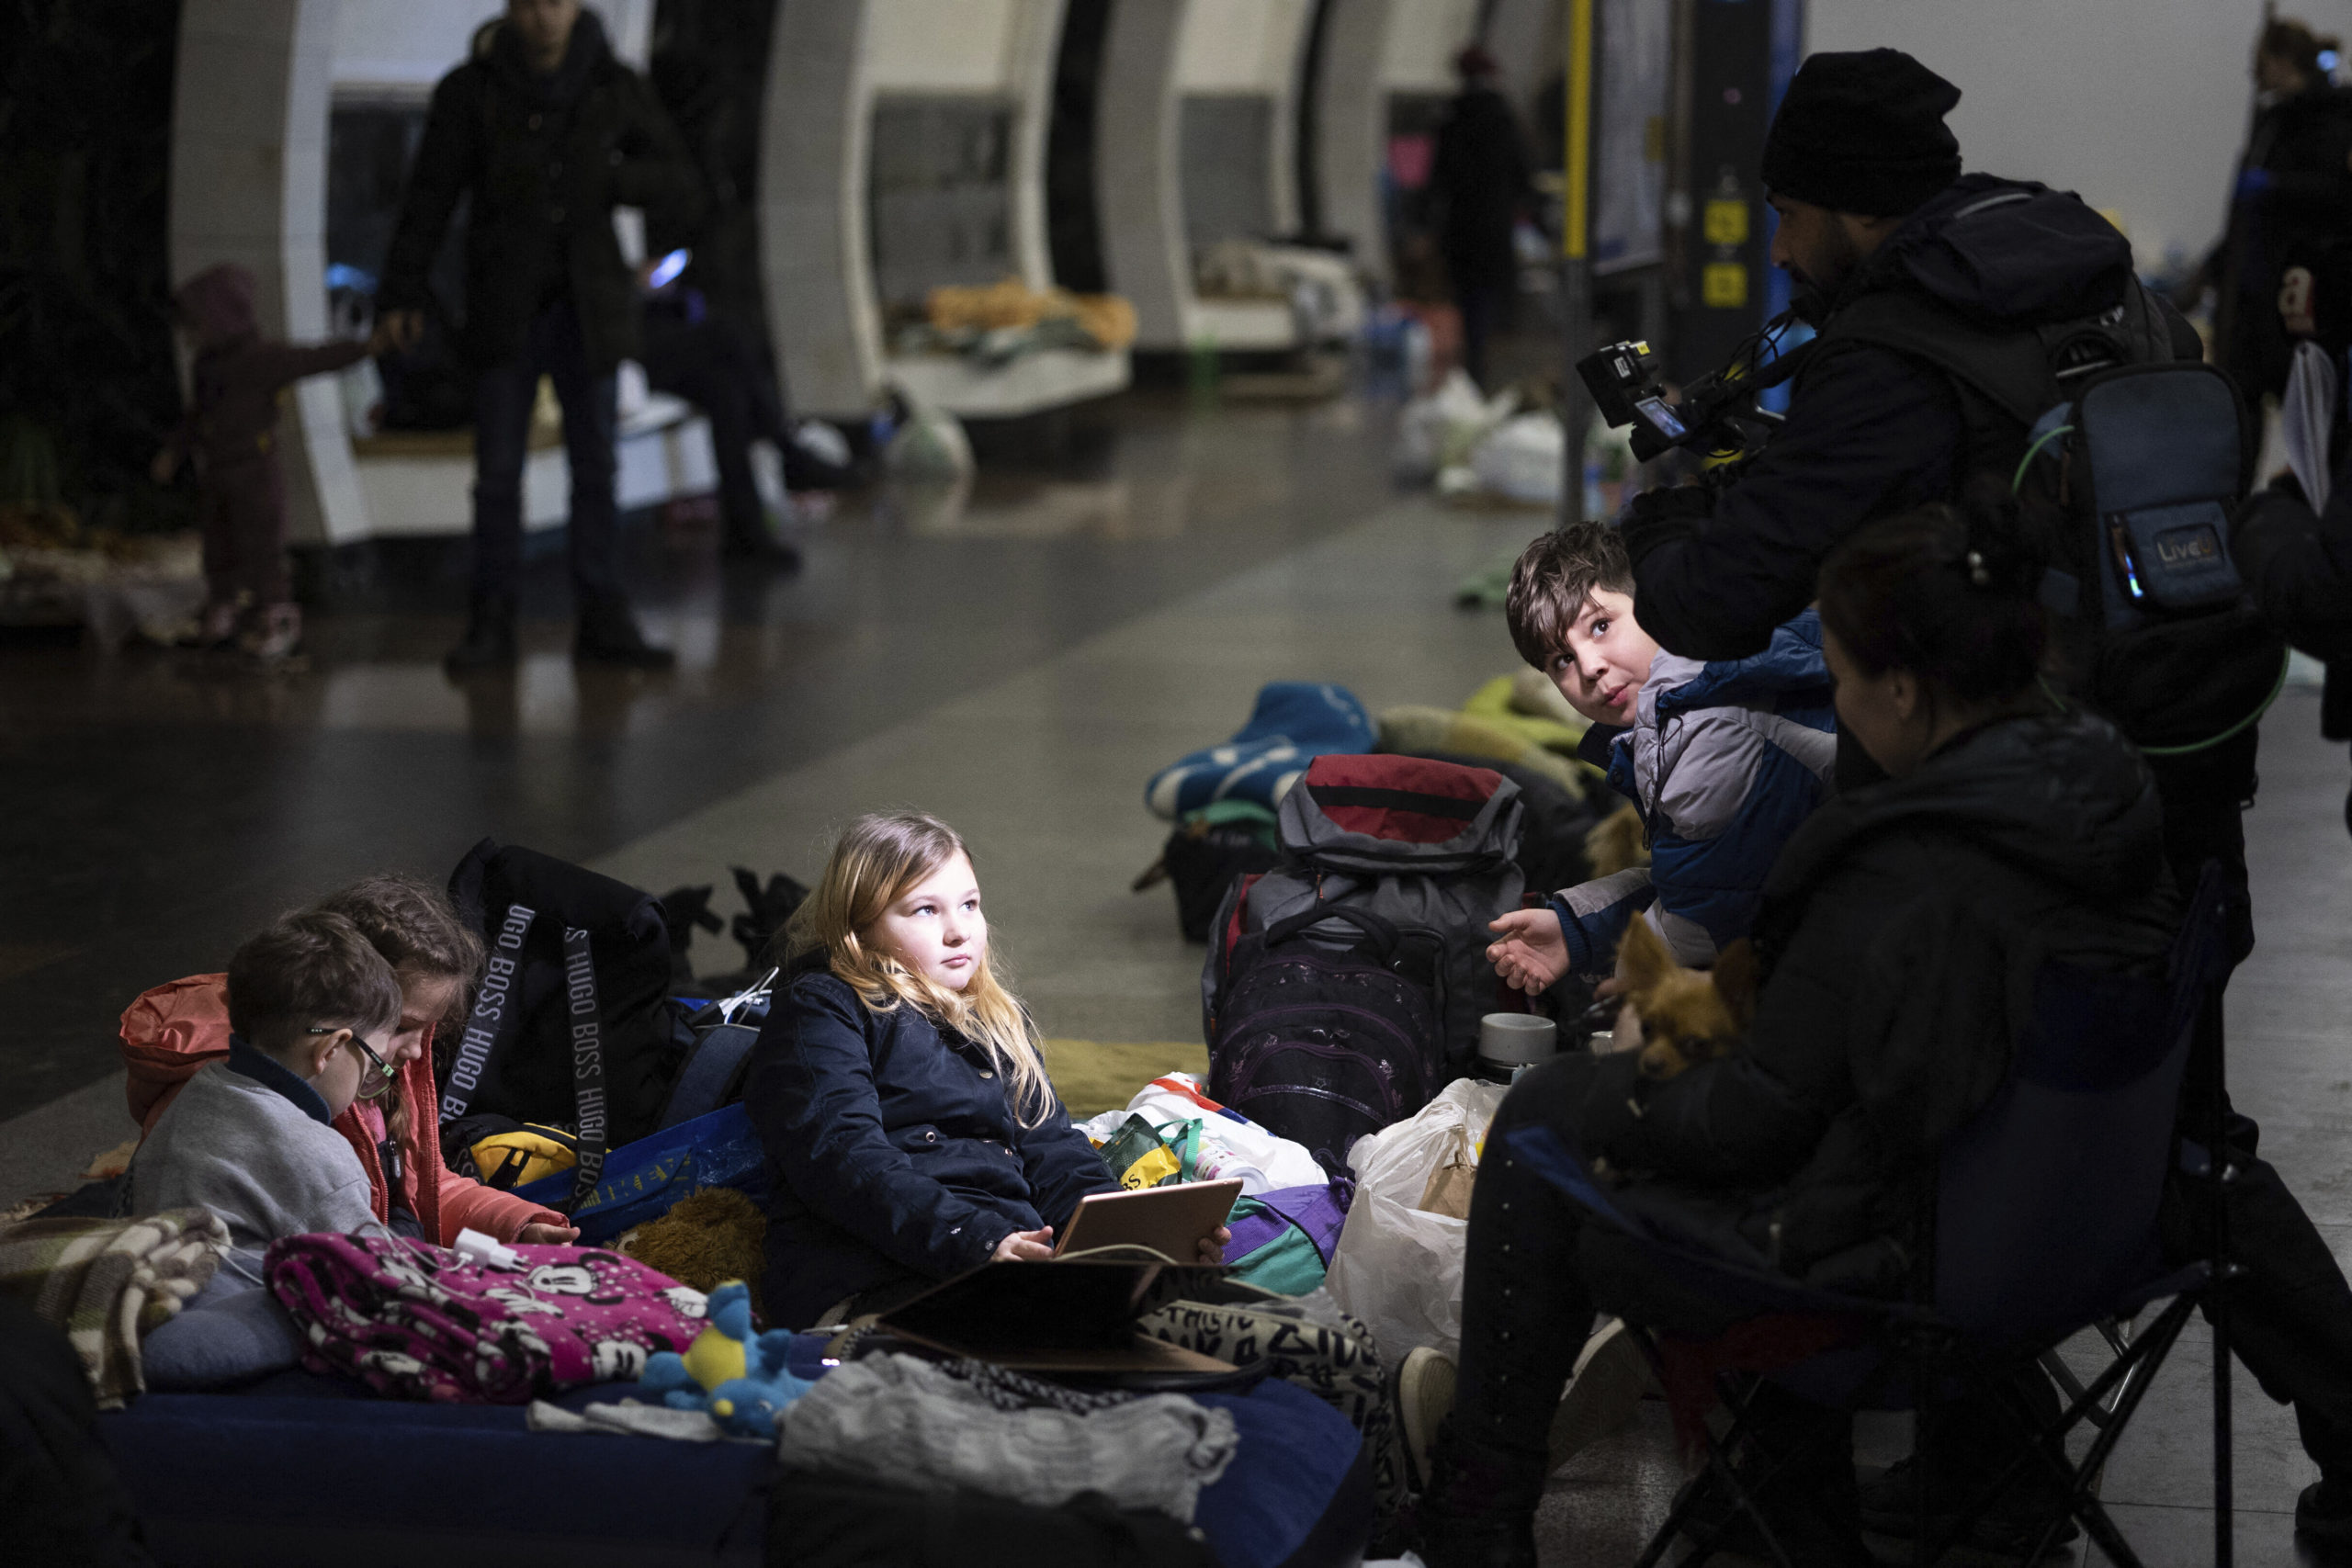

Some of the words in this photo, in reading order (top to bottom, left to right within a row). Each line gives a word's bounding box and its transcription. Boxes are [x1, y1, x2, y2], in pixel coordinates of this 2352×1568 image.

[2156, 536, 2213, 562] LiveU
[497, 904, 536, 950] UGO
[475, 956, 515, 1021] BOSS
[566, 952, 596, 1015] HUGO
[451, 1027, 493, 1091] HUGO
[573, 1022, 602, 1080] BOSS
[578, 1088, 605, 1143] HUGO
